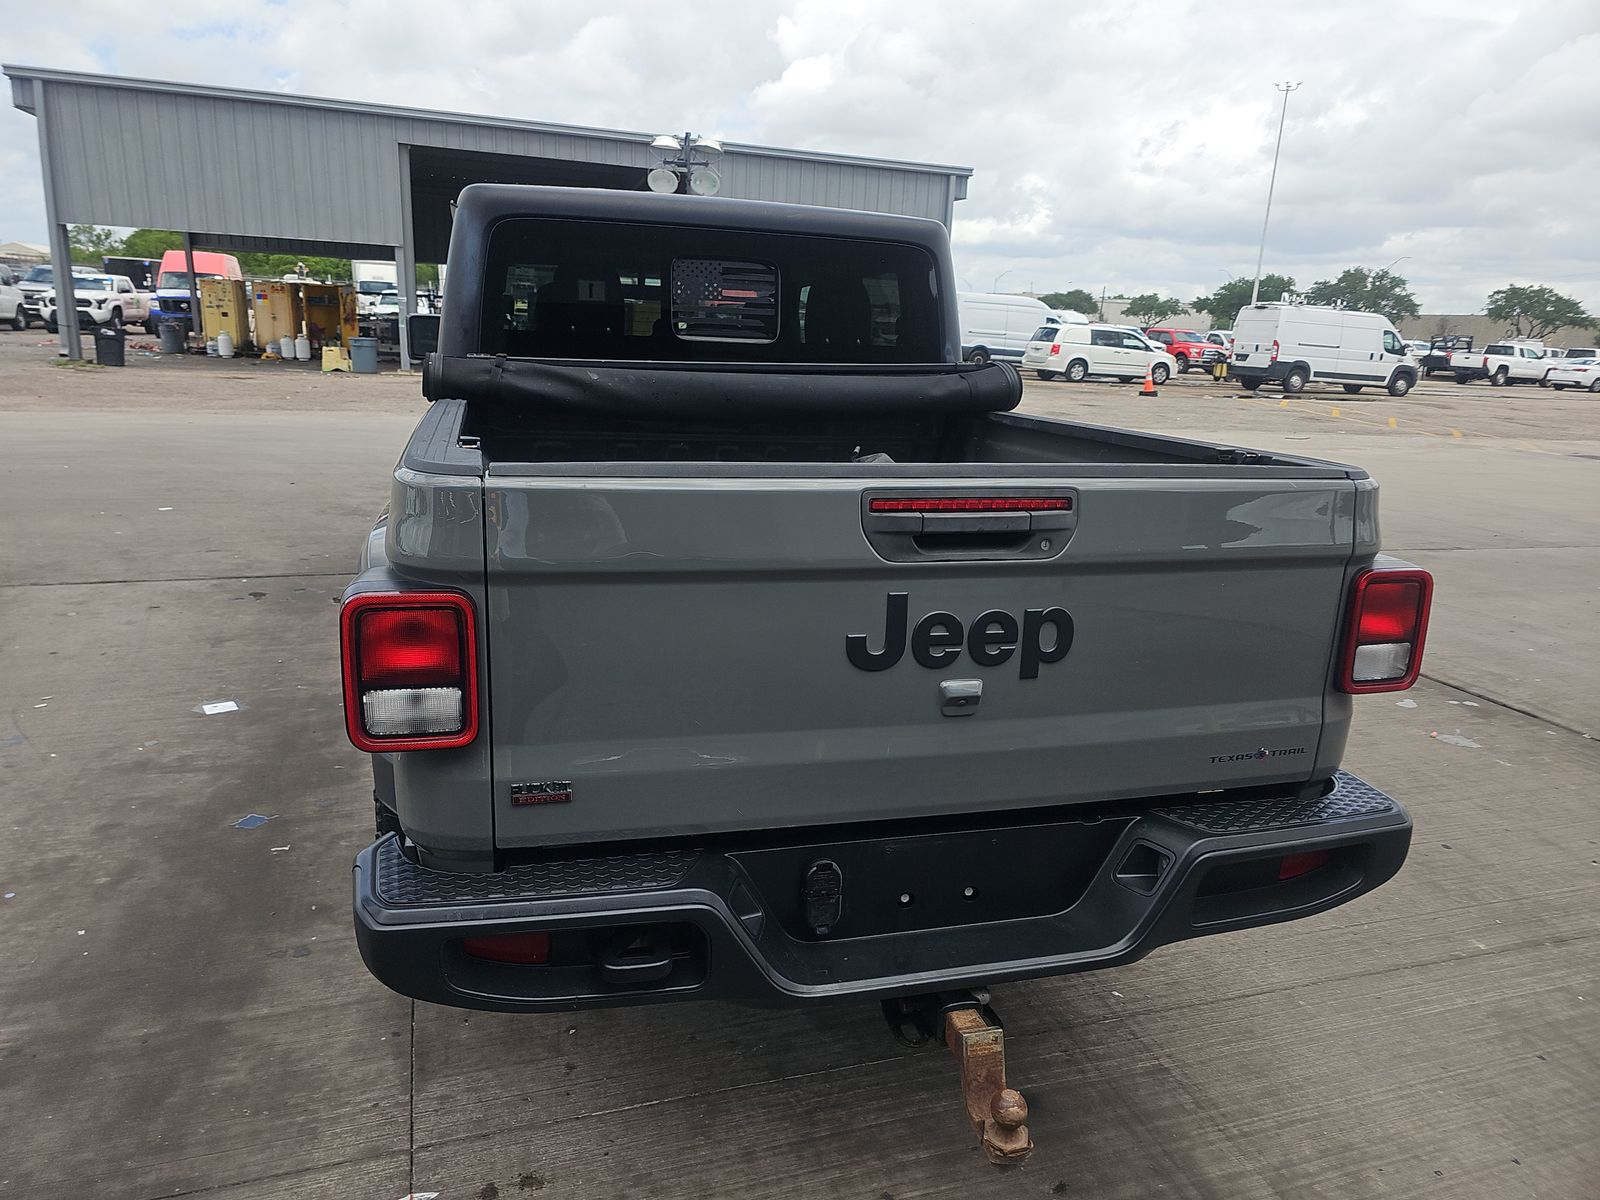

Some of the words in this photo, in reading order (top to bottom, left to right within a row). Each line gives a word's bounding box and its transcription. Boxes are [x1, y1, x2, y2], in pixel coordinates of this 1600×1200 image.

[846, 591, 1074, 680] Jeep
[1209, 752, 1253, 763] TEXAS
[1269, 747, 1307, 757] TRAIL
[518, 794, 566, 803] EDITION
